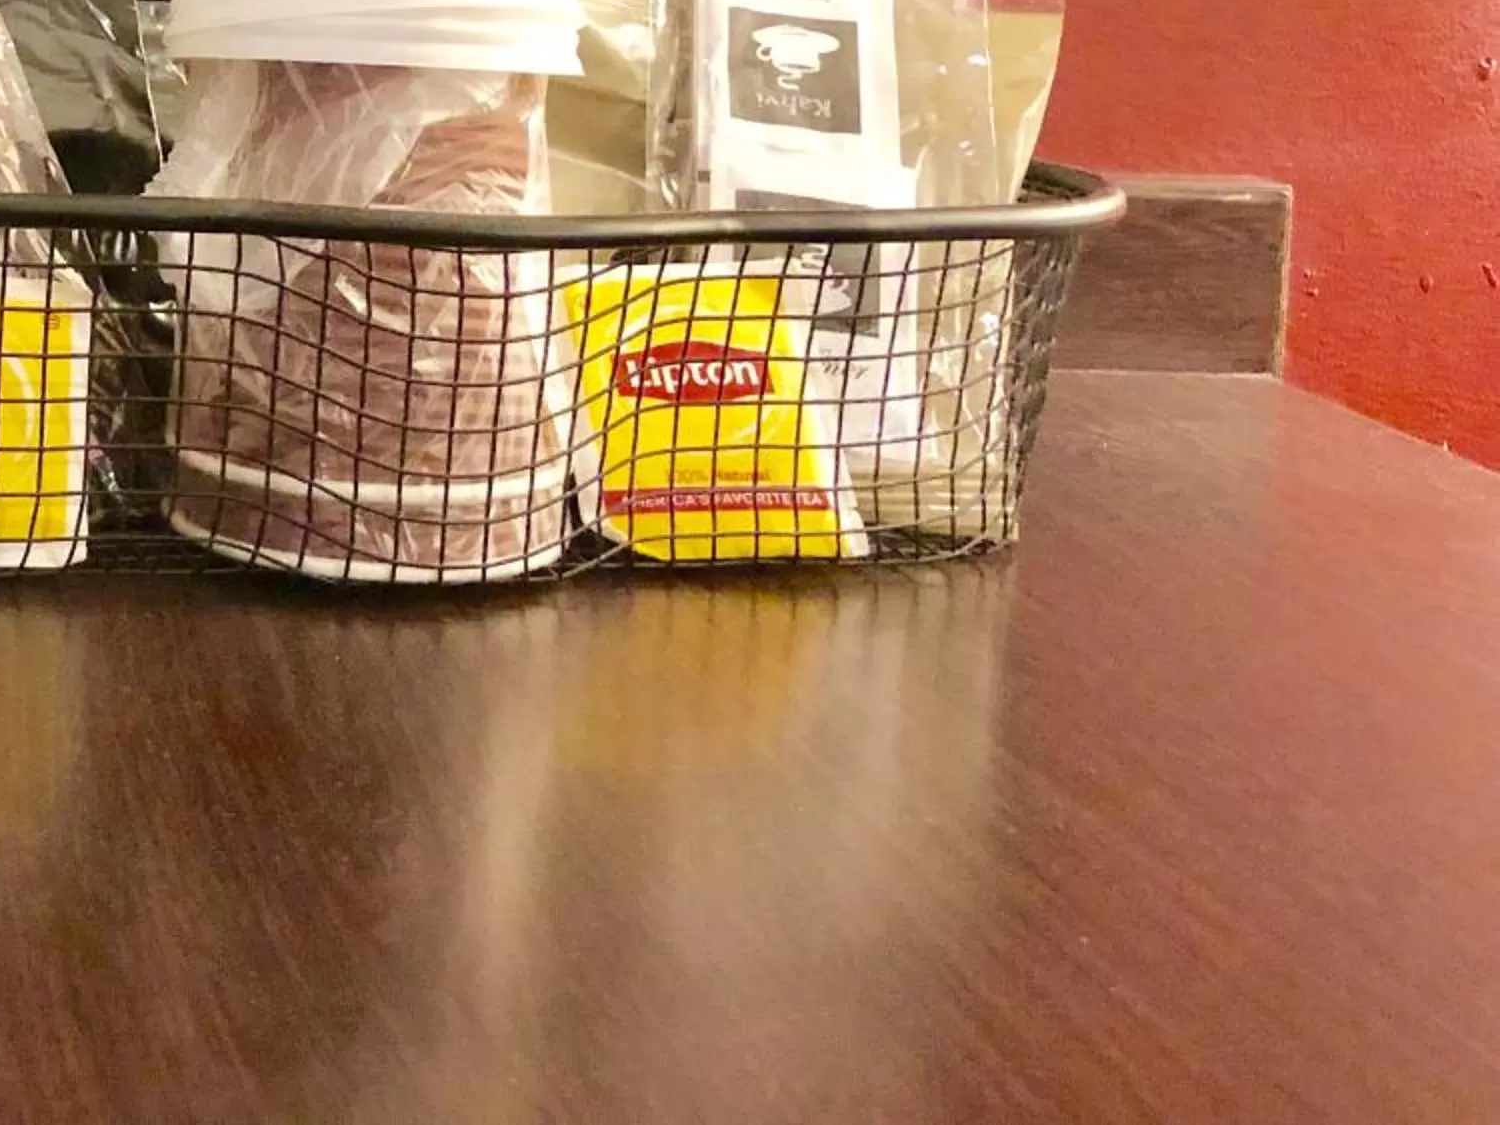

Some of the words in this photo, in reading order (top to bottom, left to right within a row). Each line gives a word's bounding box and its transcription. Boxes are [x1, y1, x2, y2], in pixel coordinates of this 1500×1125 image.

[756, 92, 832, 119] Kahvi
[626, 356, 760, 393] Lipton
[622, 493, 710, 508] MERCA'S
[712, 491, 792, 505] AVORITE
